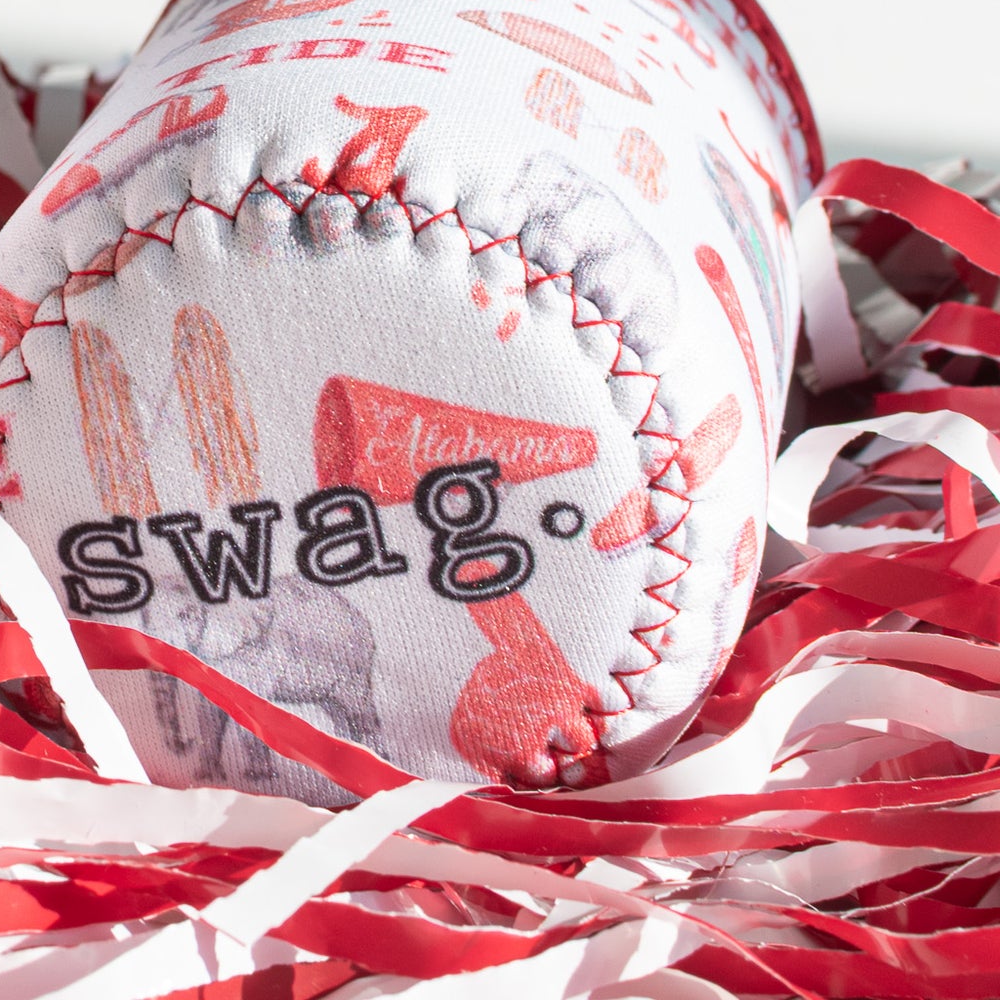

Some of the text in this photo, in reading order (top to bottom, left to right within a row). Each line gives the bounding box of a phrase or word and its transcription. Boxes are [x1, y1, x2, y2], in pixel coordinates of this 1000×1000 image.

[156, 37, 454, 92] TIDE
[365, 412, 576, 480] Alabama
[57, 458, 586, 616] swag.
